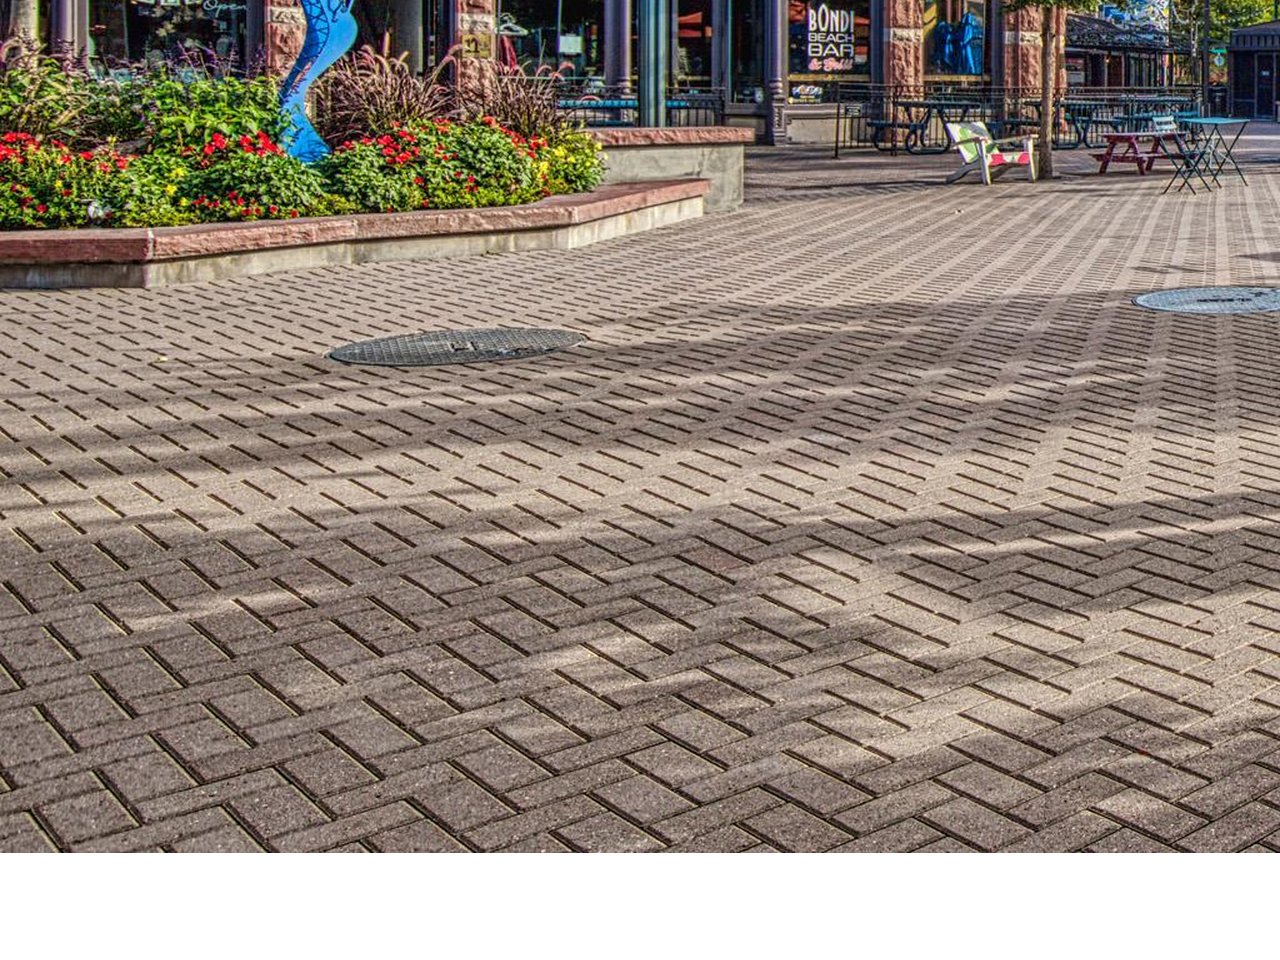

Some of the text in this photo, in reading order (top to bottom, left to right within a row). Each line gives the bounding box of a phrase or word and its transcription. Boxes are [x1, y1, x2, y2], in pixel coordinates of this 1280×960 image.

[203, 0, 248, 18] Open
[808, 3, 854, 32] BONDI
[808, 32, 854, 43] BEACH
[808, 43, 854, 57] BAR
